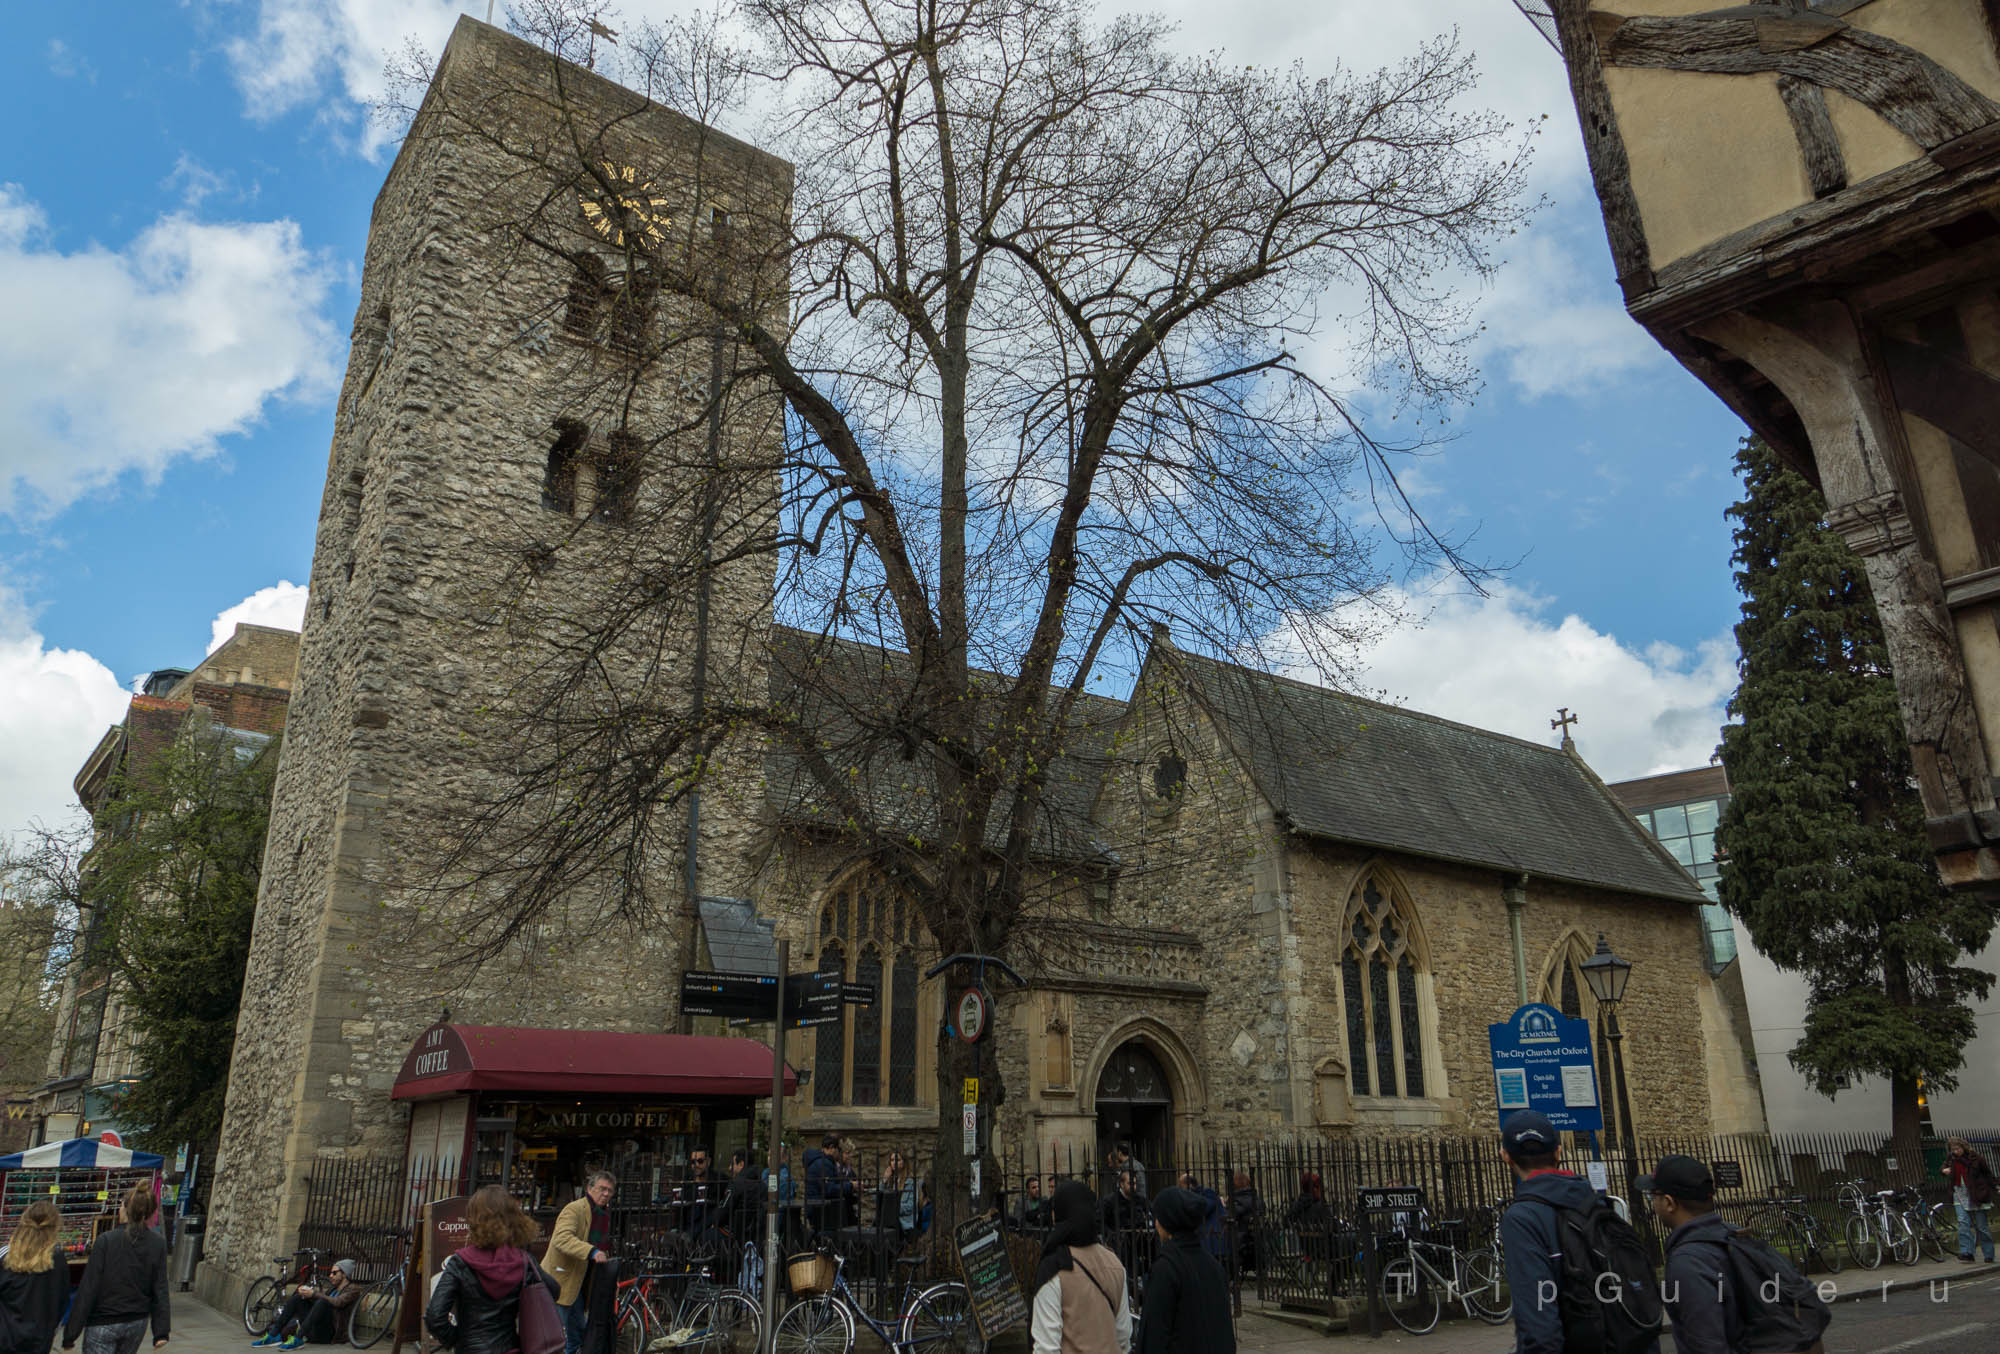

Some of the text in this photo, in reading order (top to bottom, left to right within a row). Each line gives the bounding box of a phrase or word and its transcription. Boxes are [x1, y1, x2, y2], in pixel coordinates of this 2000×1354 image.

[425, 1028, 445, 1048] AMT
[1496, 1046, 1588, 1058] The City Church of Oxford
[415, 1049, 449, 1076] COFFEE
[7, 1105, 27, 1120] W
[547, 1111, 669, 1128] AMT COFFEE
[1365, 1193, 1417, 1208] SHIP STREET
